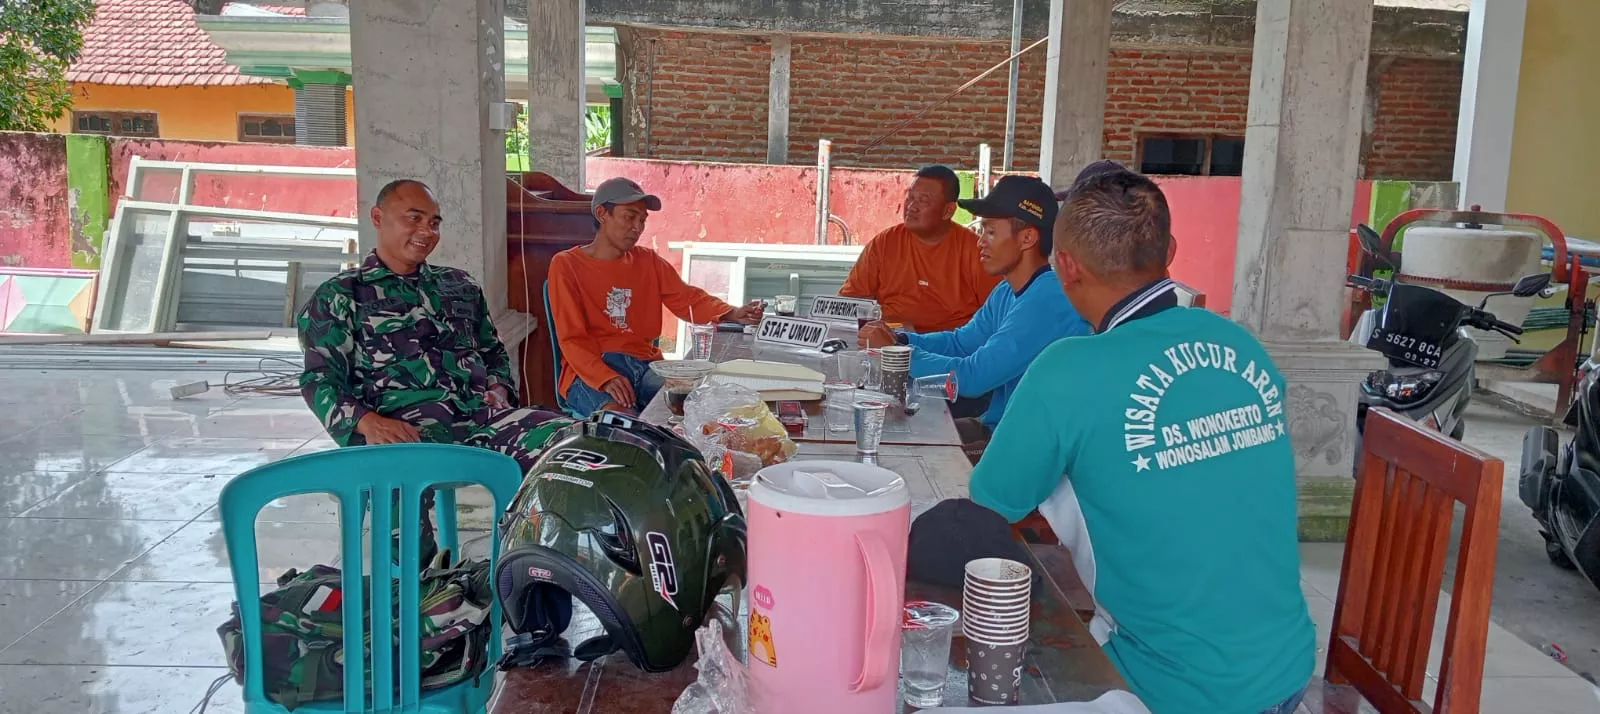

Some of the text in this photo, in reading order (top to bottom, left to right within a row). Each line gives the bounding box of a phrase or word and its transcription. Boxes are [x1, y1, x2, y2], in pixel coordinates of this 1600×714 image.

[814, 300, 862, 318] STAF PEMERINTA
[762, 320, 822, 343] STAF UMUM
[1372, 328, 1382, 339] S
[1385, 333, 1416, 349] 5627
[1124, 341, 1282, 452] WISATA KUCUR AREN
[1161, 404, 1262, 447] DS. WONOKERTO
[1155, 423, 1276, 470] WONOSALAM JOMBANG
